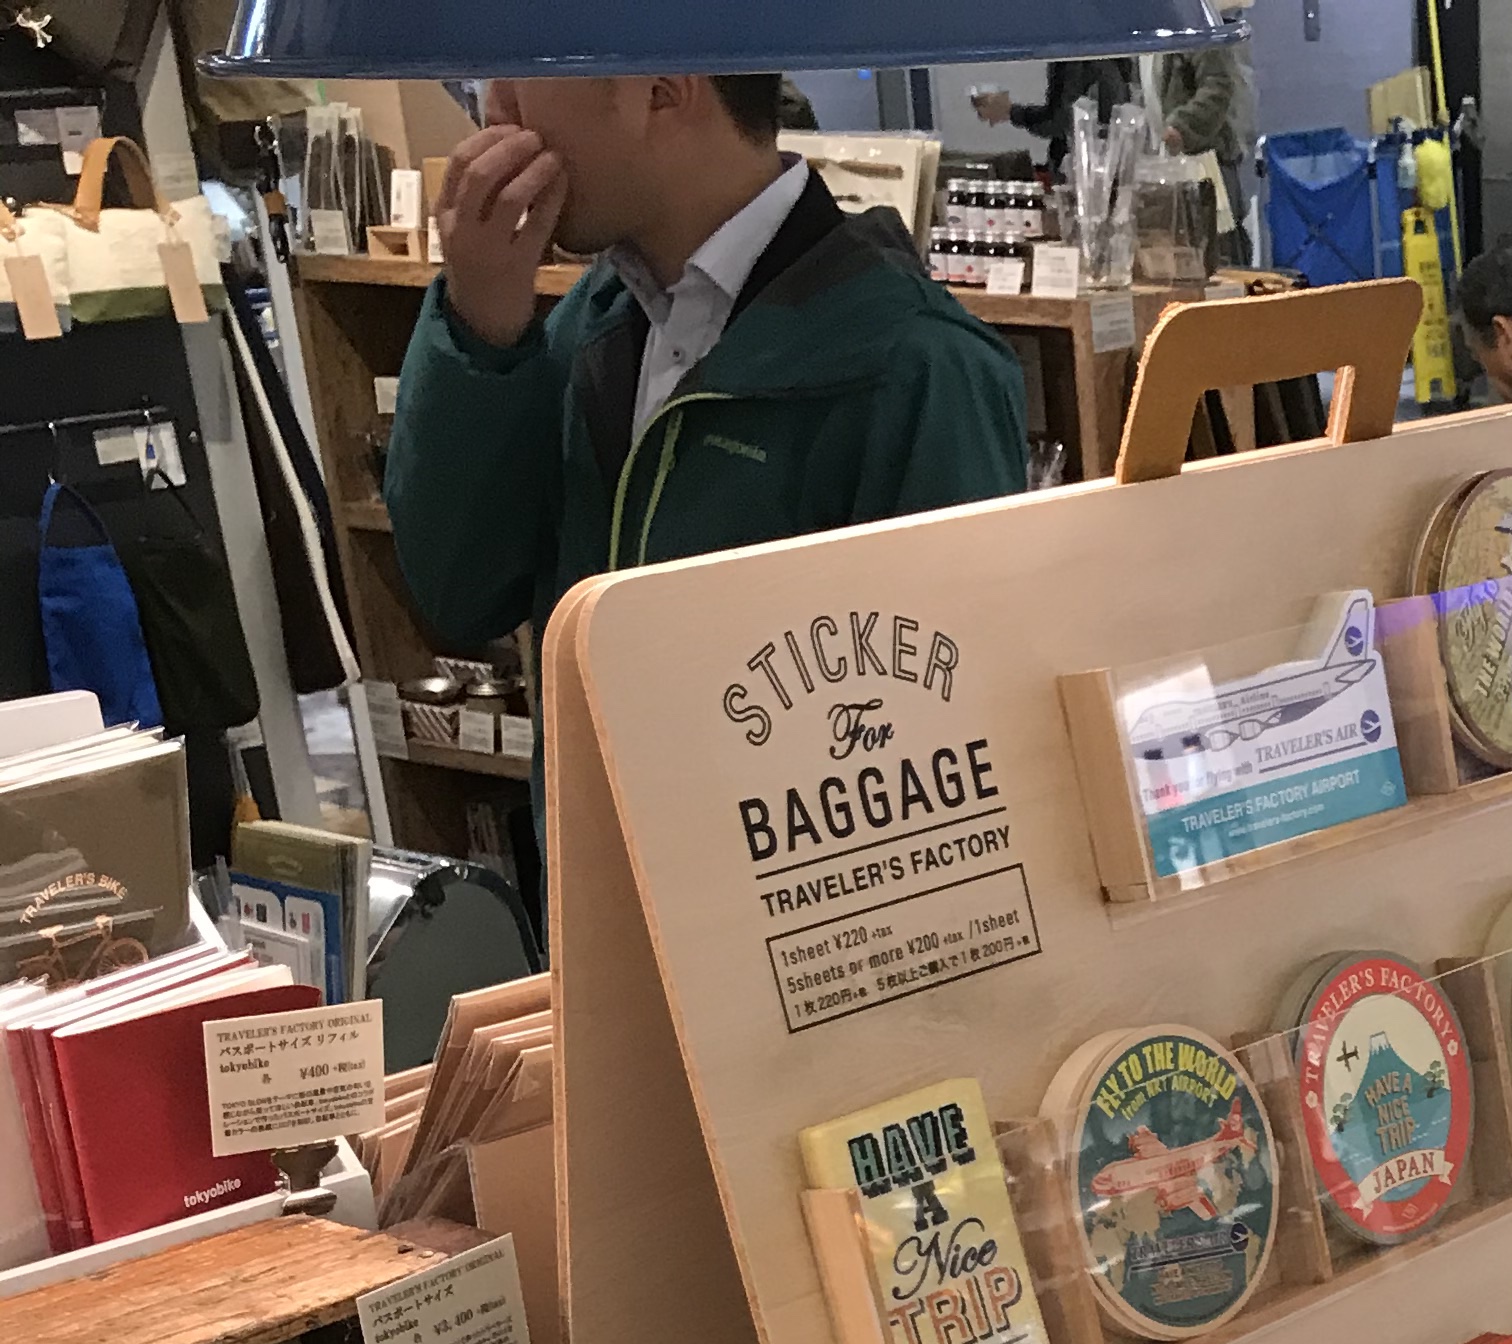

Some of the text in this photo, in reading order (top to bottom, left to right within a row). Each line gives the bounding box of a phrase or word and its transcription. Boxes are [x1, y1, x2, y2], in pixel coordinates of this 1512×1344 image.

[723, 611, 960, 746] STICKER
[827, 698, 895, 760] For
[1255, 723, 1359, 764] TRAVELER'S AIR
[738, 738, 1000, 861] BAGGAGE
[1181, 798, 1254, 833] TRAVELER'S
[1256, 785, 1309, 813] FACTORY
[1311, 769, 1361, 797] AIRPORT
[760, 826, 1011, 917] TRAVELER'S FACTORY
[20, 873, 129, 926] TRAVELER'S BIKE
[781, 939, 832, 968] 1sheet
[786, 946, 905, 995] 5sheets more
[216, 1012, 373, 1043] TRAVELER'S FACTORY ORIGINAL
[218, 1030, 360, 1057] パスポートサイズ リフィル
[1305, 966, 1456, 1084] TRAVELER'S FACTORY
[219, 1058, 270, 1074] tokyobike
[299, 1063, 330, 1080] ¥400
[1096, 1041, 1238, 1119] FLY TO THE WORLD
[1365, 1076, 1401, 1108] HAVE
[847, 1102, 977, 1199] HAVE
[1375, 1120, 1416, 1157] TRIP
[183, 1176, 242, 1211] tokyobike
[1372, 1152, 1438, 1195] JAPAN
[911, 1178, 949, 1234] A
[891, 1217, 999, 1300] Nice
